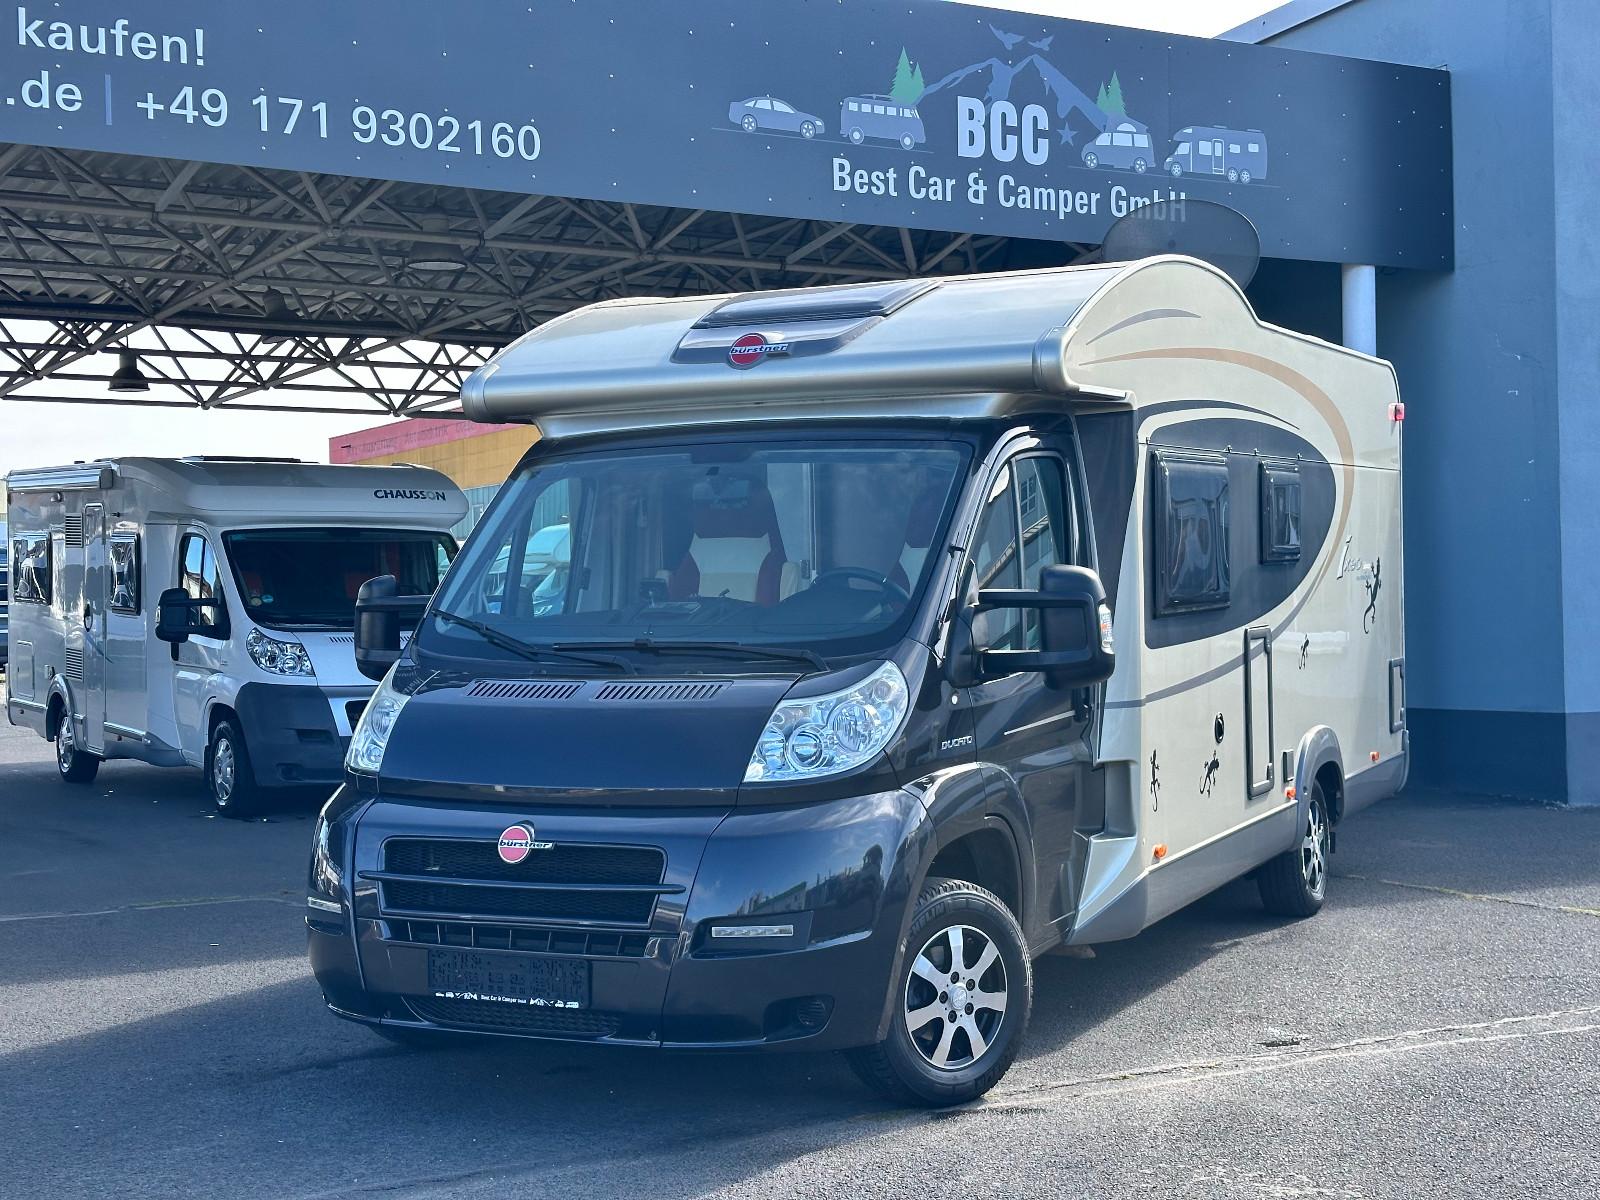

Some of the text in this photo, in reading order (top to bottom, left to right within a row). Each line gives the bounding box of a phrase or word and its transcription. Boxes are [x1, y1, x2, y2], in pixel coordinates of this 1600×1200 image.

[17, 6, 205, 66] kaufen!
[136, 85, 228, 127] +49
[252, 94, 328, 139] 171
[352, 105, 541, 161] 9302160
[957, 95, 1049, 166] BCC
[832, 157, 1186, 222] Best Car & Camper GmbH
[373, 489, 447, 501] CHAUSSON
